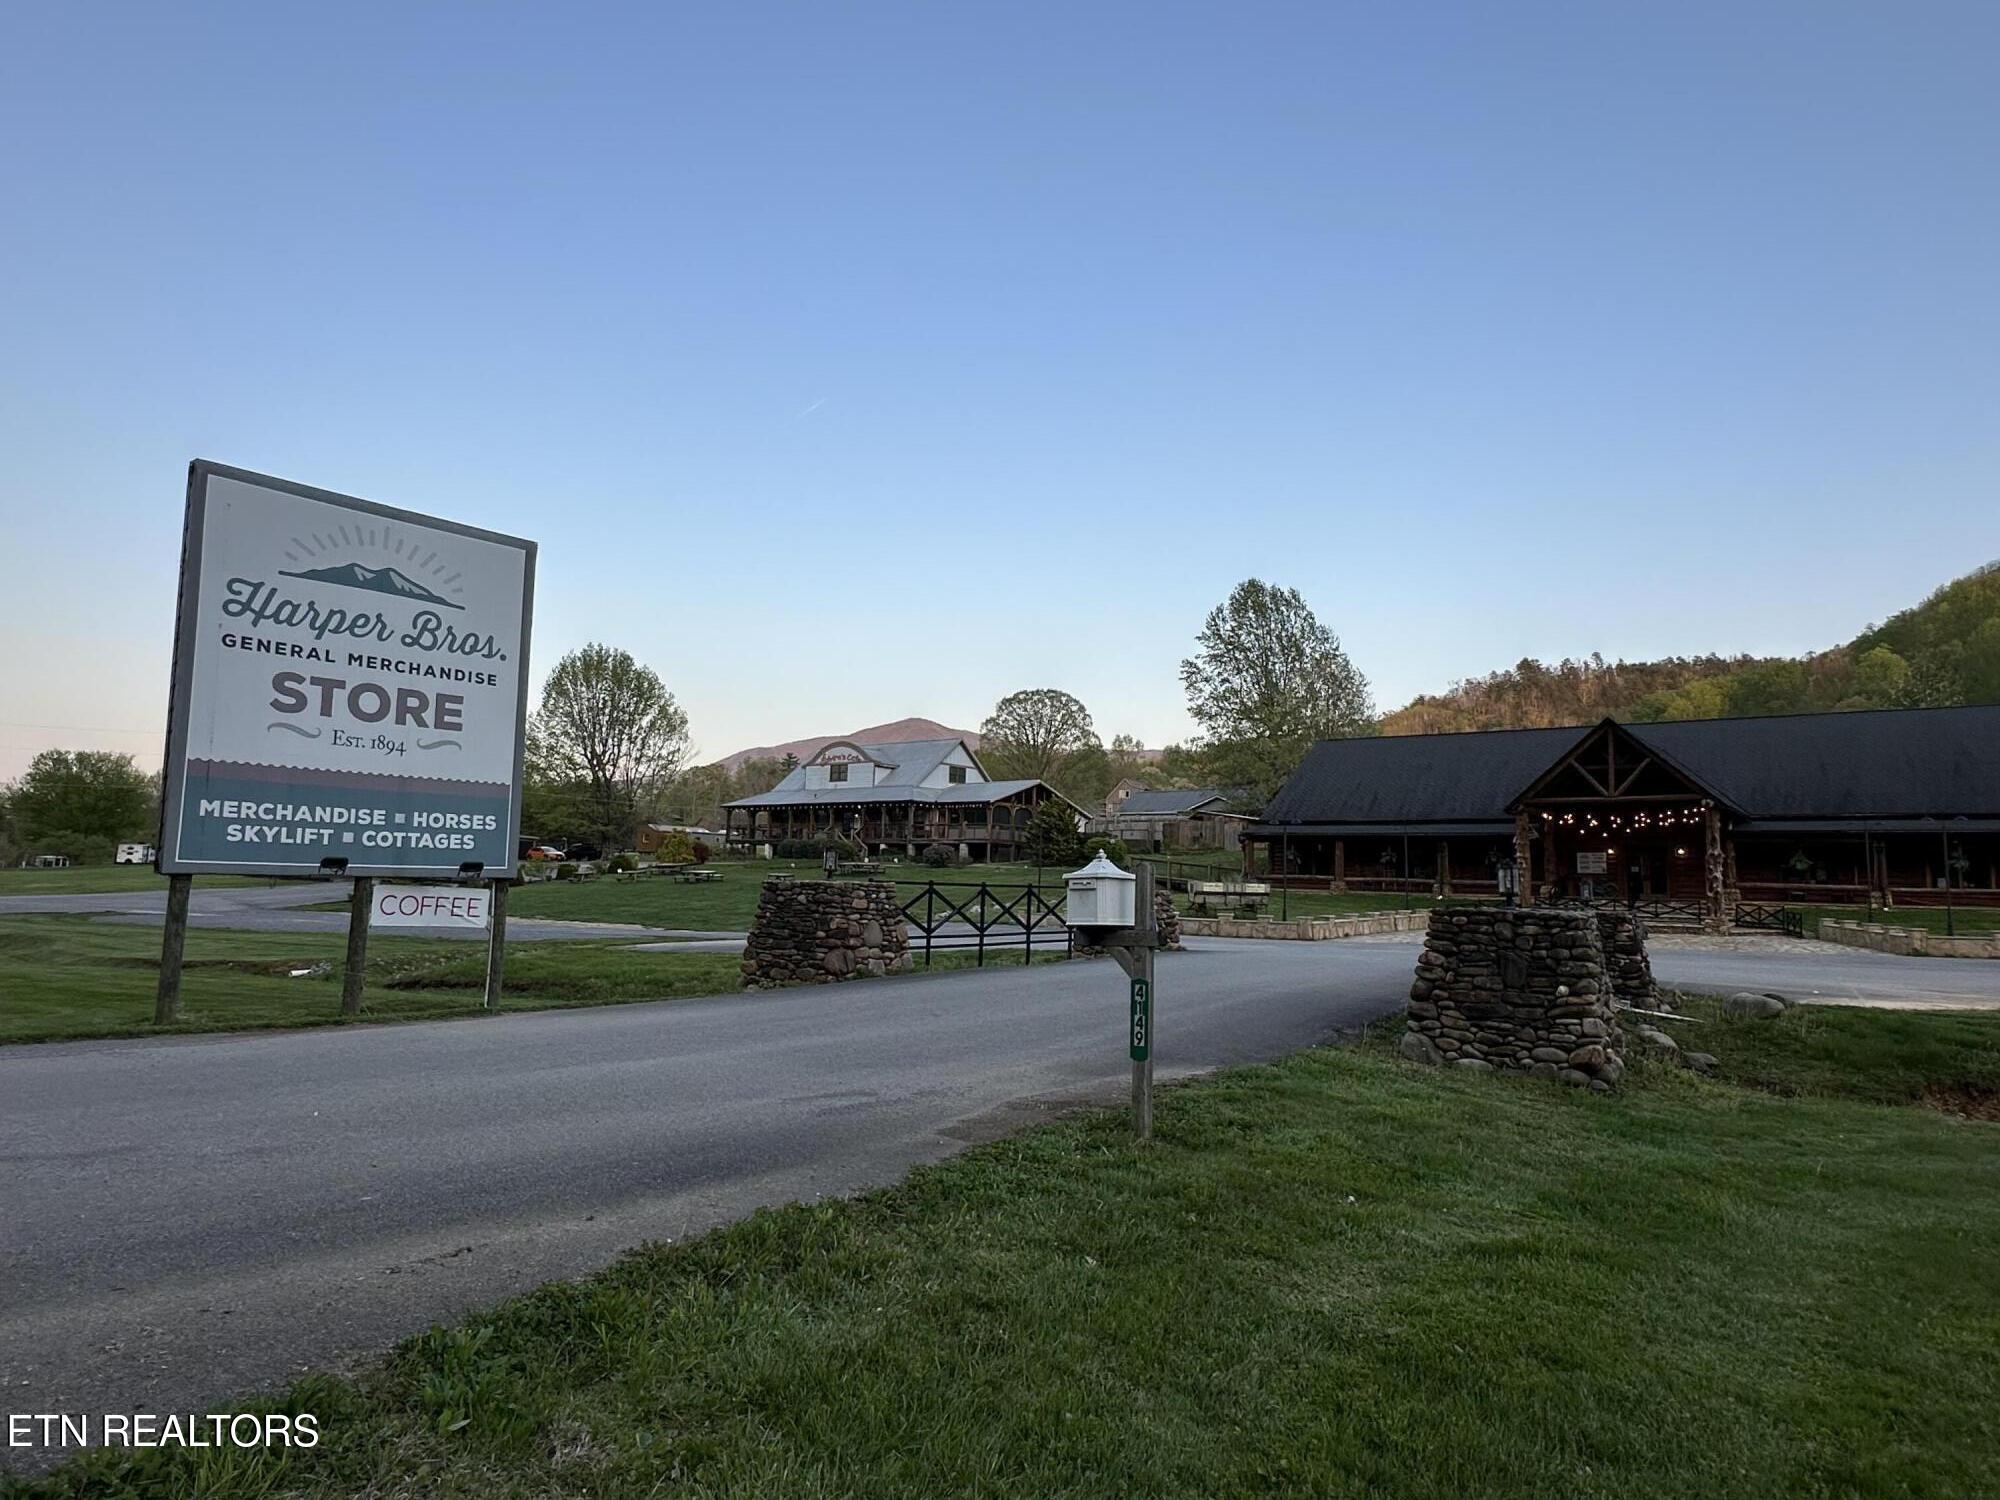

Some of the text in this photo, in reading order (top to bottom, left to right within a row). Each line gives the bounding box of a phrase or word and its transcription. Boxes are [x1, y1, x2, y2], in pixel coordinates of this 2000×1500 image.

[222, 578, 507, 661] Harper Bros.
[221, 633, 497, 686] GENERAL MERCHANDISE
[270, 671, 464, 731] STORE
[371, 734, 407, 757] 1894
[199, 799, 497, 830] MERCHANDISE HORSES
[226, 825, 475, 849] SKYLIFT COTTAGES
[380, 895, 482, 917] COFFEE
[1135, 985, 1144, 1046] 4149
